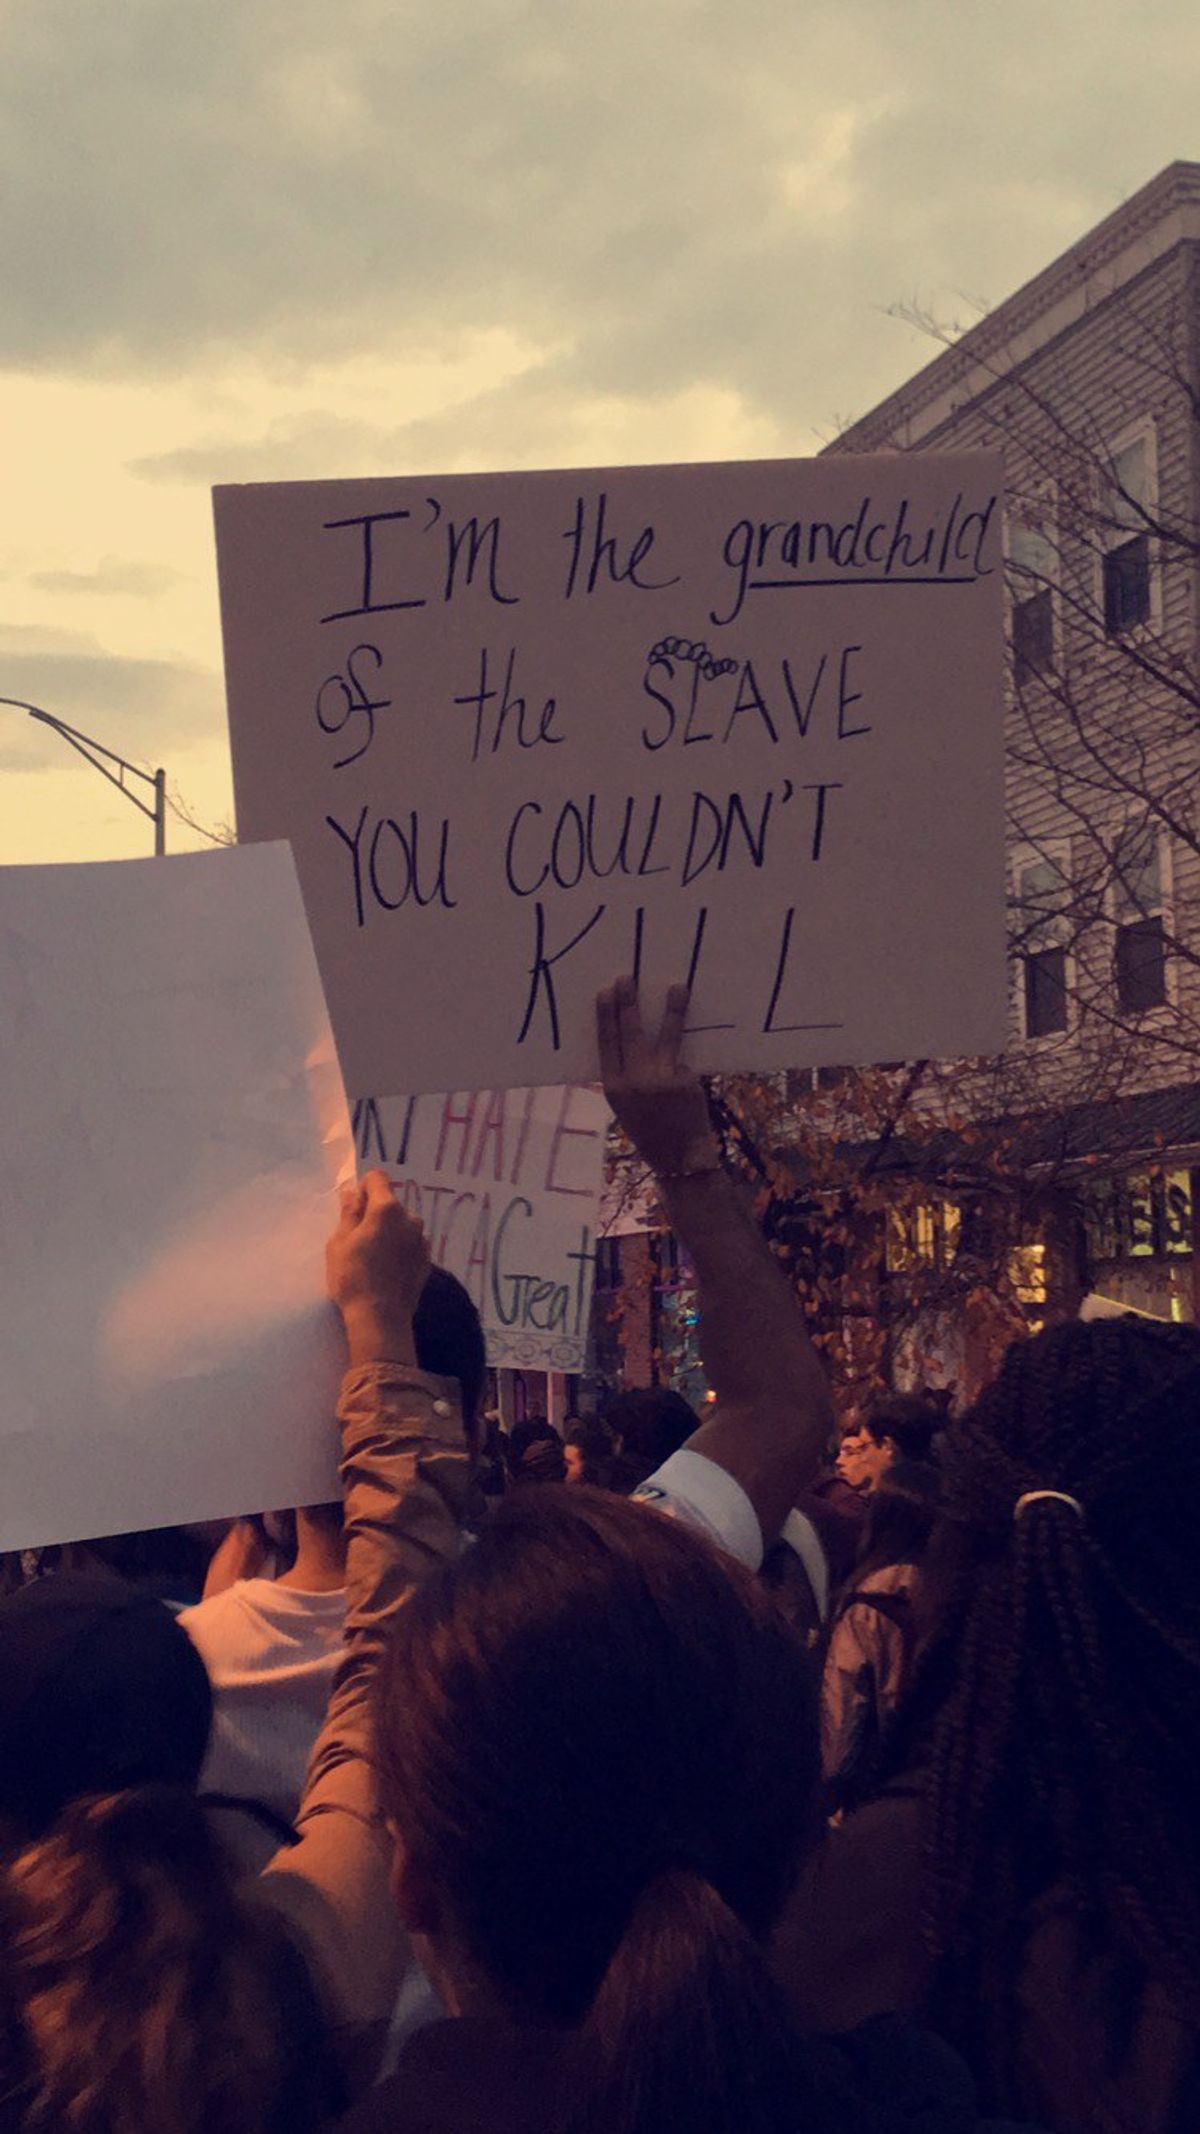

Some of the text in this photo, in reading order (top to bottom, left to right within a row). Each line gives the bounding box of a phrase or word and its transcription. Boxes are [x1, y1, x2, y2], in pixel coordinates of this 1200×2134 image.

[321, 493, 997, 625] I'm the grandchild
[315, 644, 871, 769] of the SLAVE
[325, 779, 844, 927] YOU COULDN'T
[516, 902, 843, 1051] KILL
[491, 1196, 598, 1336] Great
